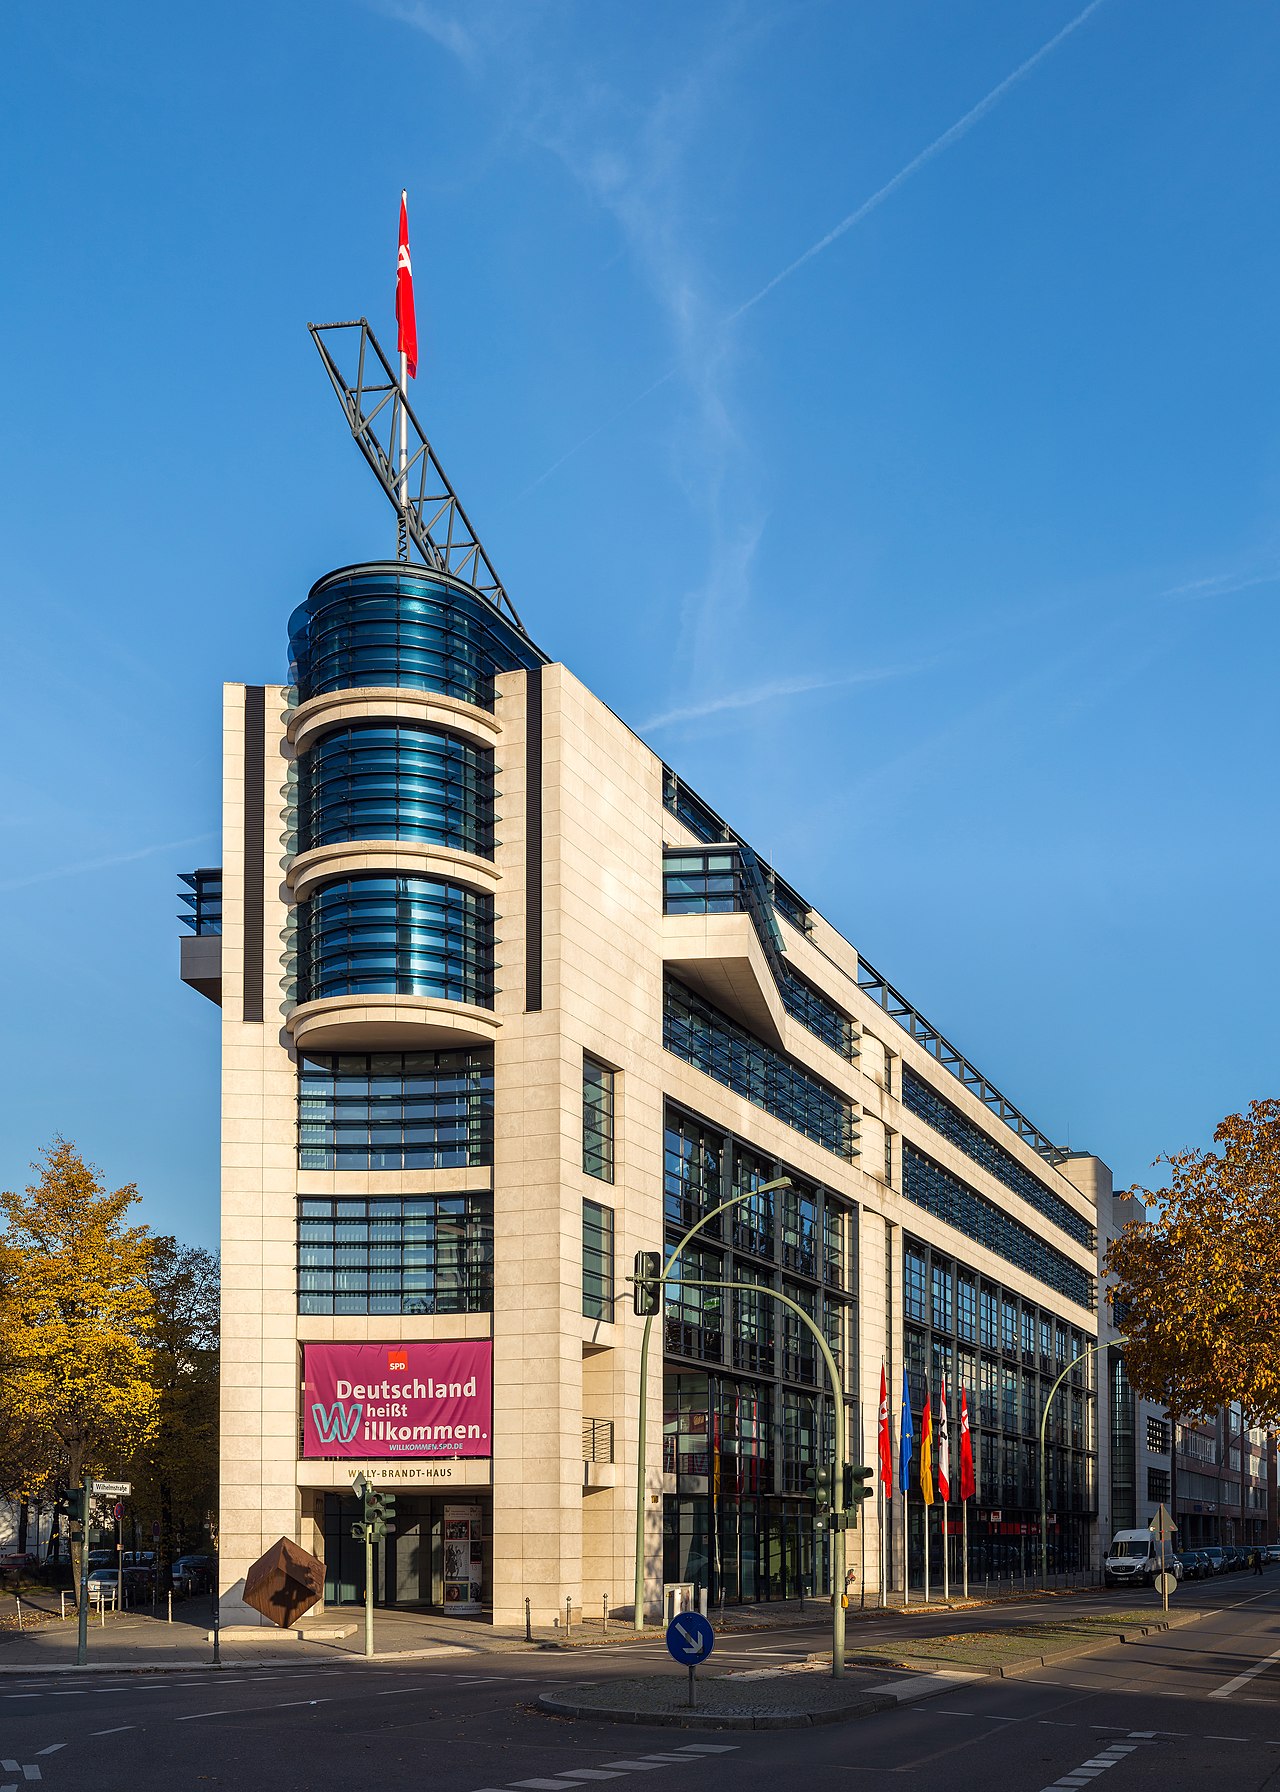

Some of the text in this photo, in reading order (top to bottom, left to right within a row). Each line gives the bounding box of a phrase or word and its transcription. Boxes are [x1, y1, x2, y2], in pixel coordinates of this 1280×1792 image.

[389, 1362, 405, 1370] SPD
[336, 1377, 476, 1400] Deutschland
[366, 1404, 408, 1417] heißt
[389, 1443, 463, 1451] WILLKOMMEN.SPD.DE
